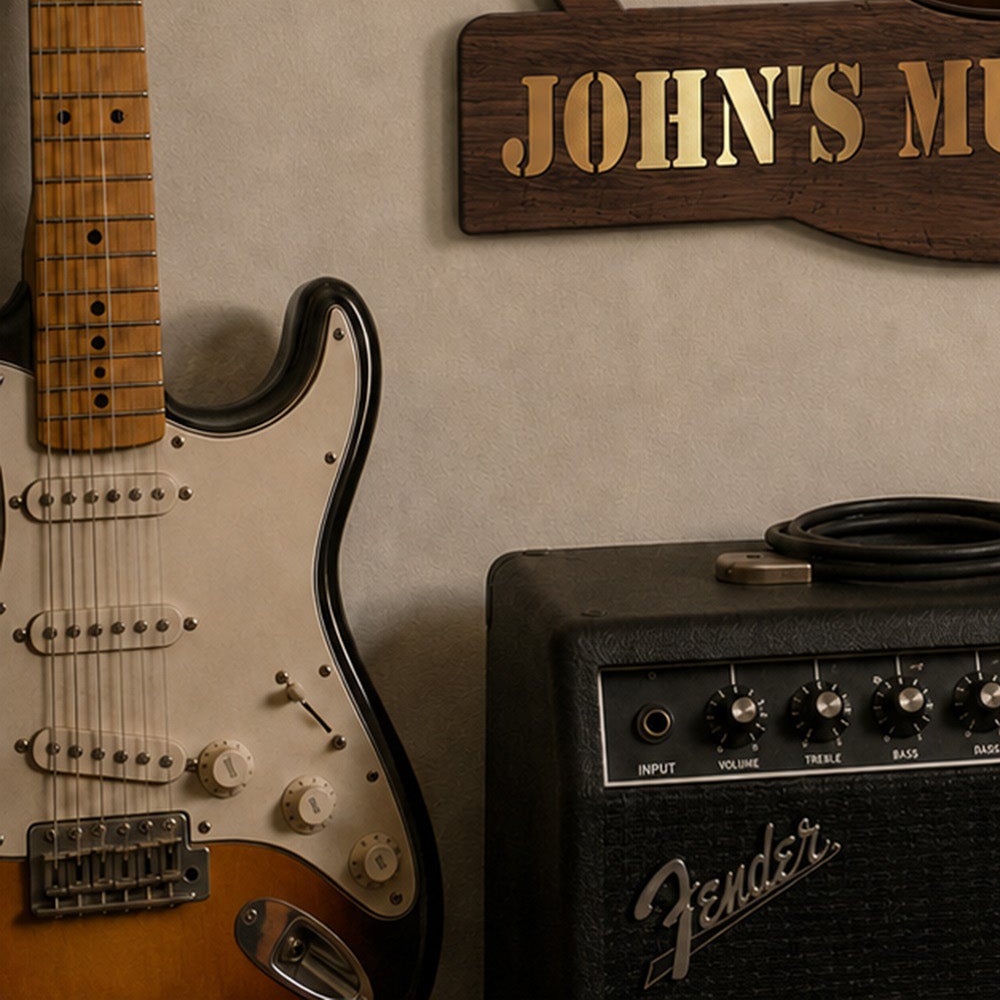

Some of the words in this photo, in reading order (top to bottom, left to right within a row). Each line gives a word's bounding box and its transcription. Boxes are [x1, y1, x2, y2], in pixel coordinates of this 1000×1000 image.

[502, 62, 864, 177] JOHN'S
[638, 762, 676, 776] INPUT
[718, 758, 760, 771] VOLUME
[634, 818, 833, 980] Fender
